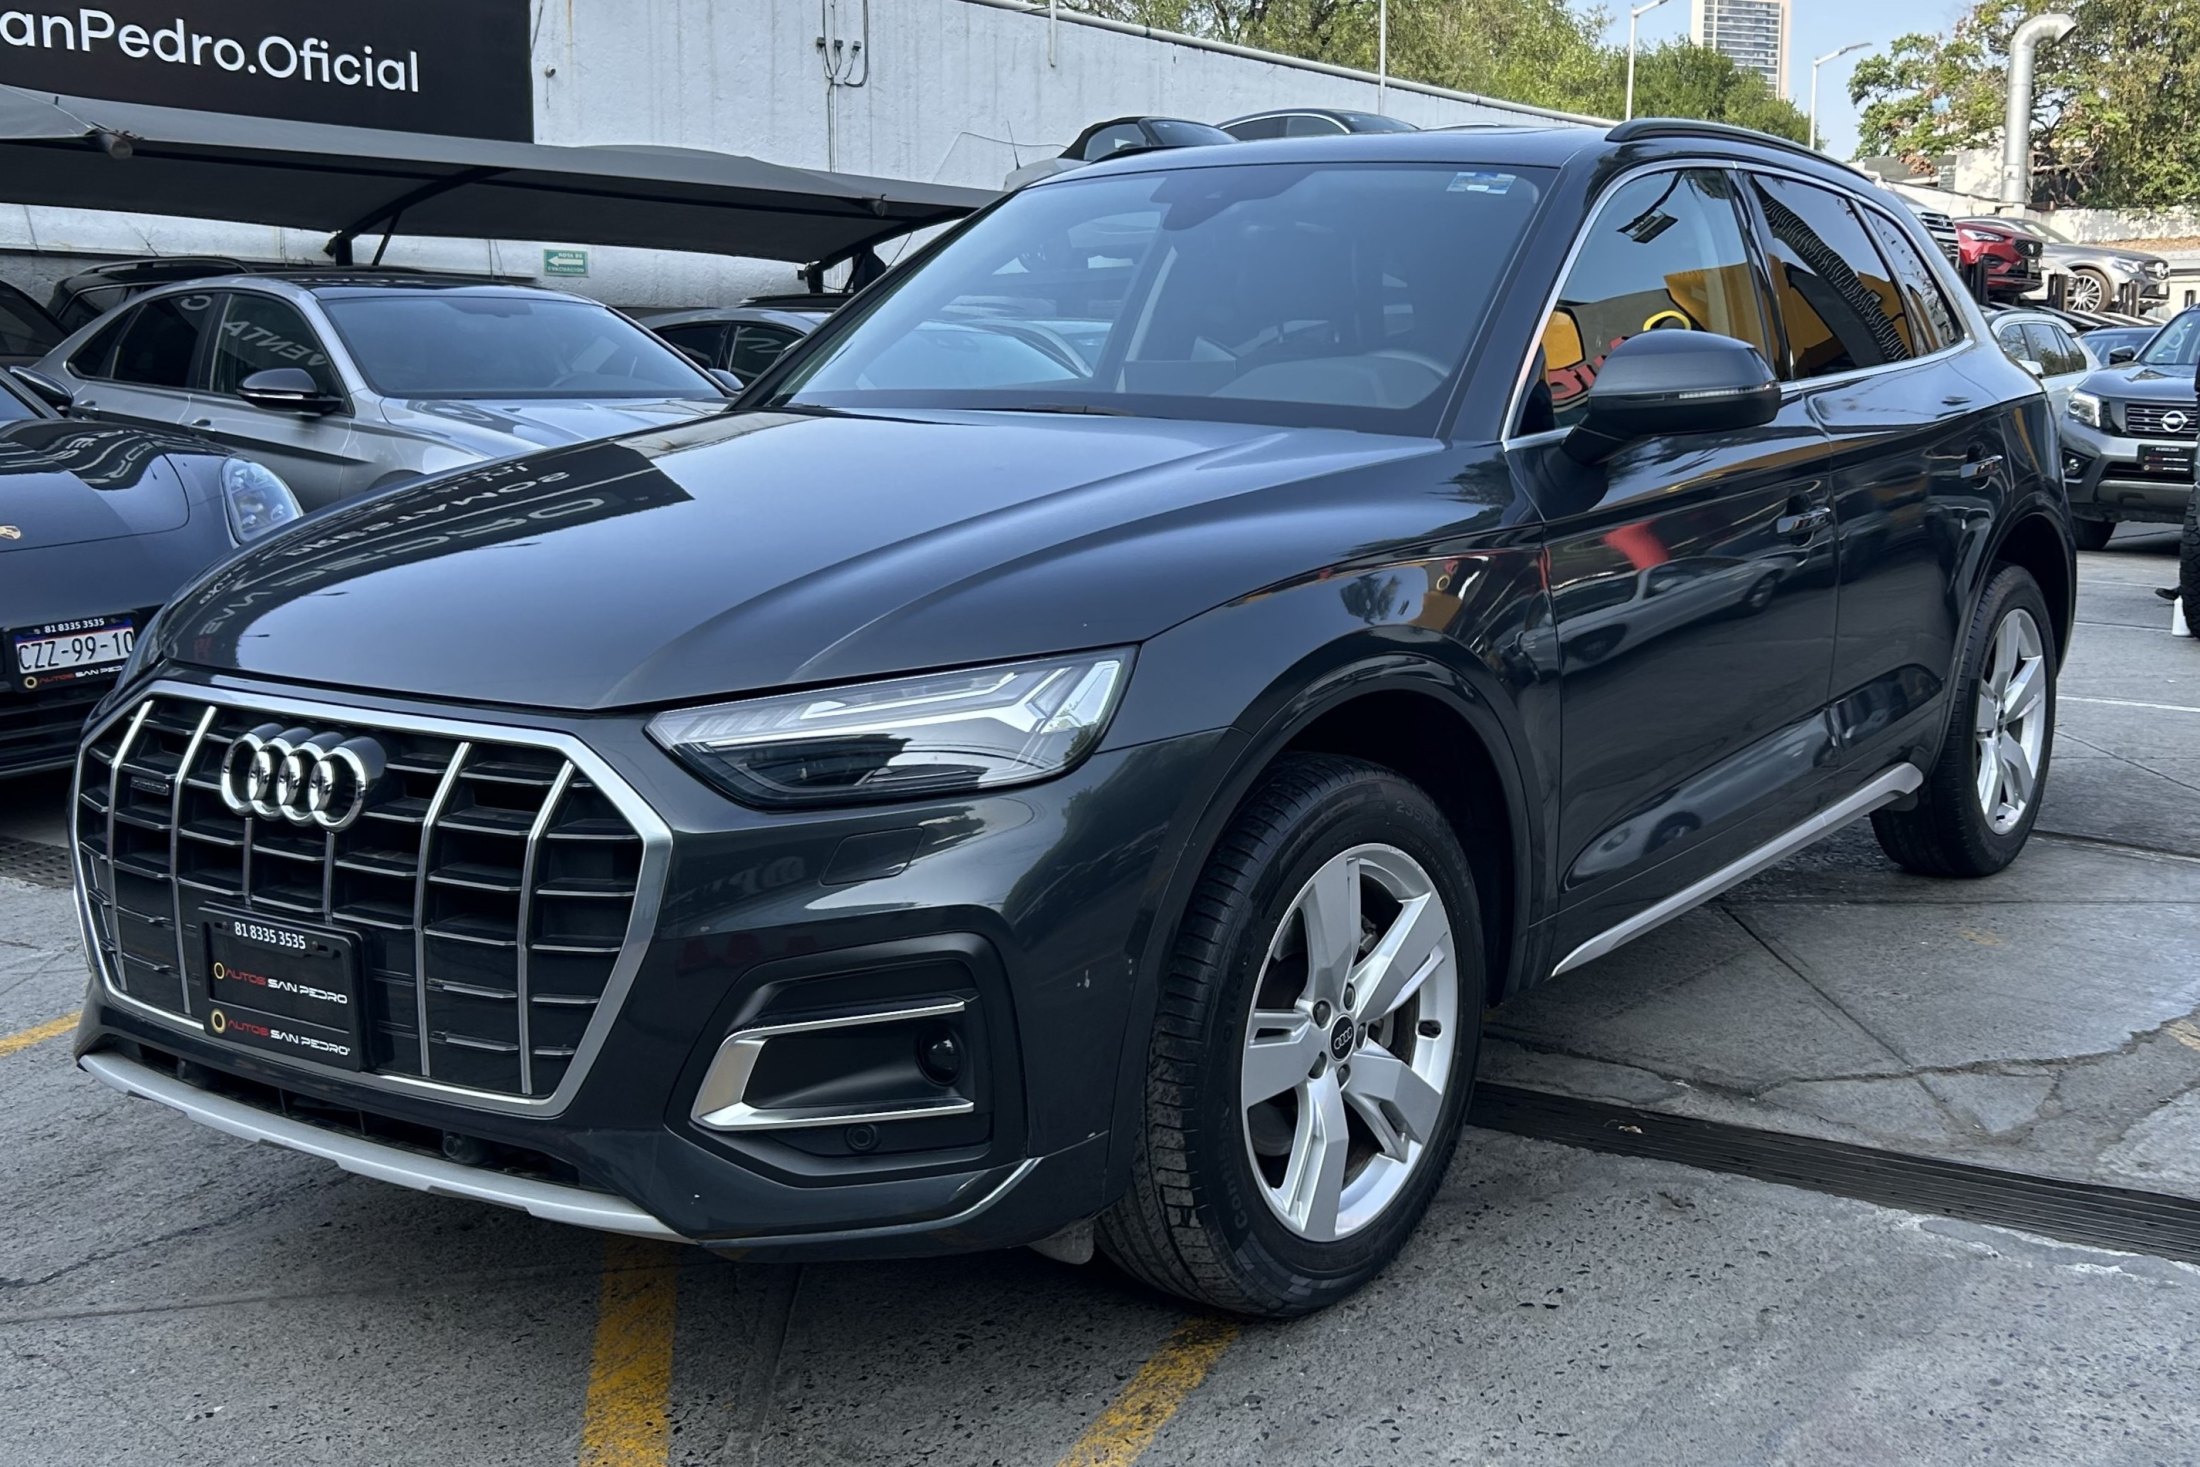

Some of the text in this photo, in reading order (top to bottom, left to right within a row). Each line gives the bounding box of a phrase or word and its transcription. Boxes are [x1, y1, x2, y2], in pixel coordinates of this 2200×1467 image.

[44, 617, 105, 634] 81 8335 3535
[75, 668, 99, 678] SAN
[234, 921, 306, 950] 81 8335 3535
[225, 968, 348, 1004] AUTOS SAN PEDRO
[228, 1020, 270, 1037] AUTOS
[270, 1029, 299, 1044] SAN
